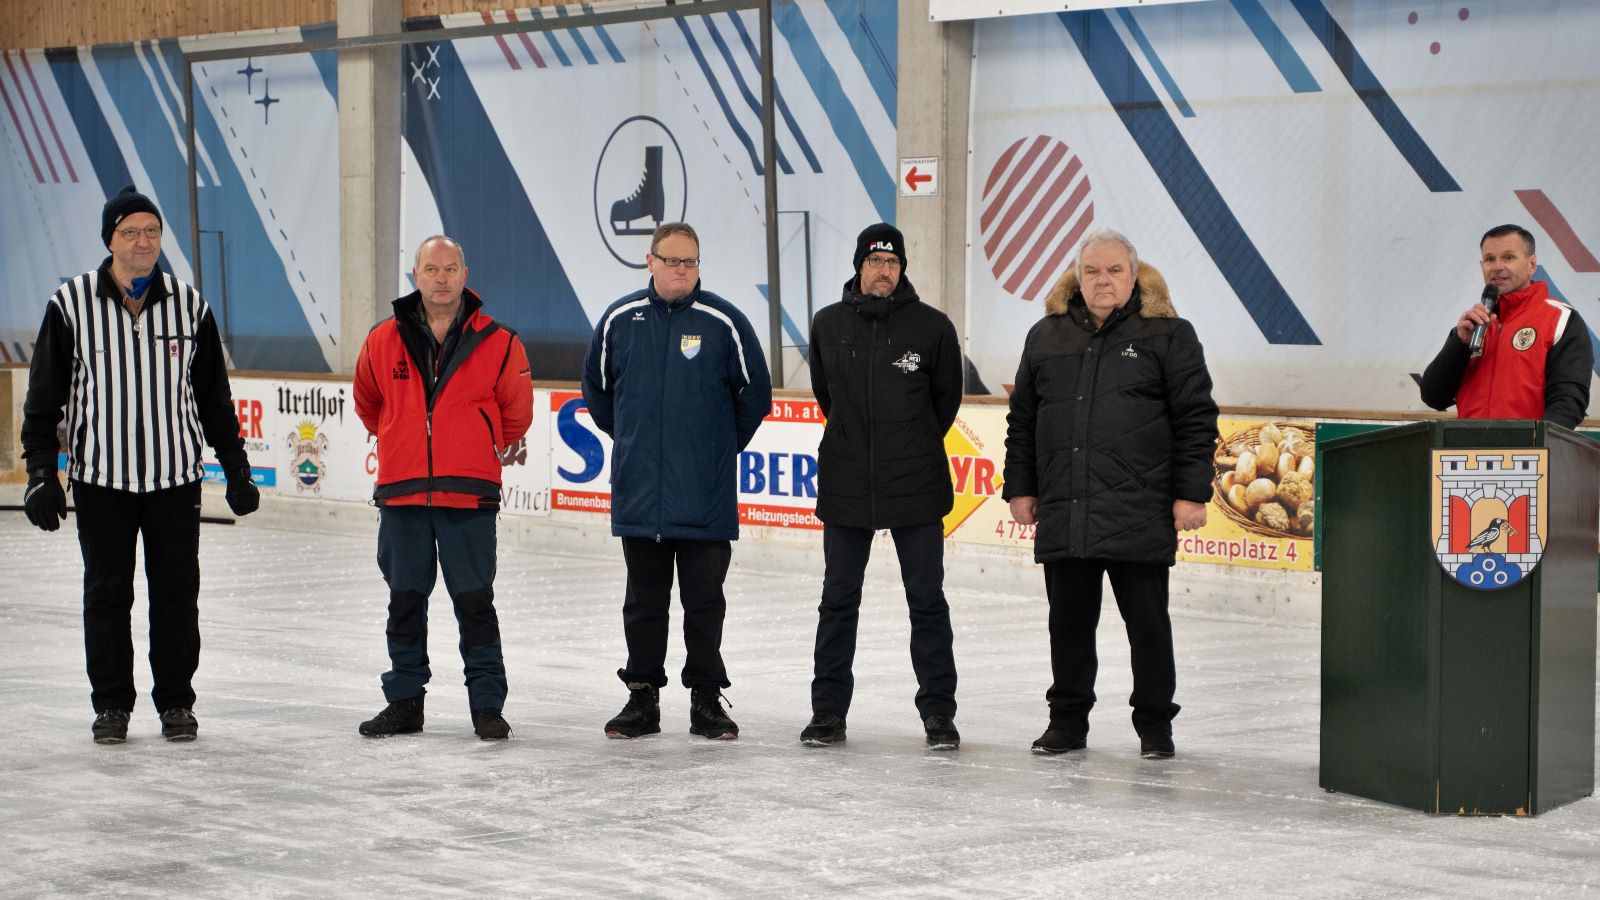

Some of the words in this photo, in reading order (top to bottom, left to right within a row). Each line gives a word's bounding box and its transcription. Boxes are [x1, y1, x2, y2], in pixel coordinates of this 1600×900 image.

[870, 241, 894, 250] FILA
[231, 399, 263, 439] ER
[278, 386, 345, 427] Urtlhof
[557, 398, 611, 484] S
[500, 484, 549, 511] Vinci
[1285, 542, 1298, 562] 4
